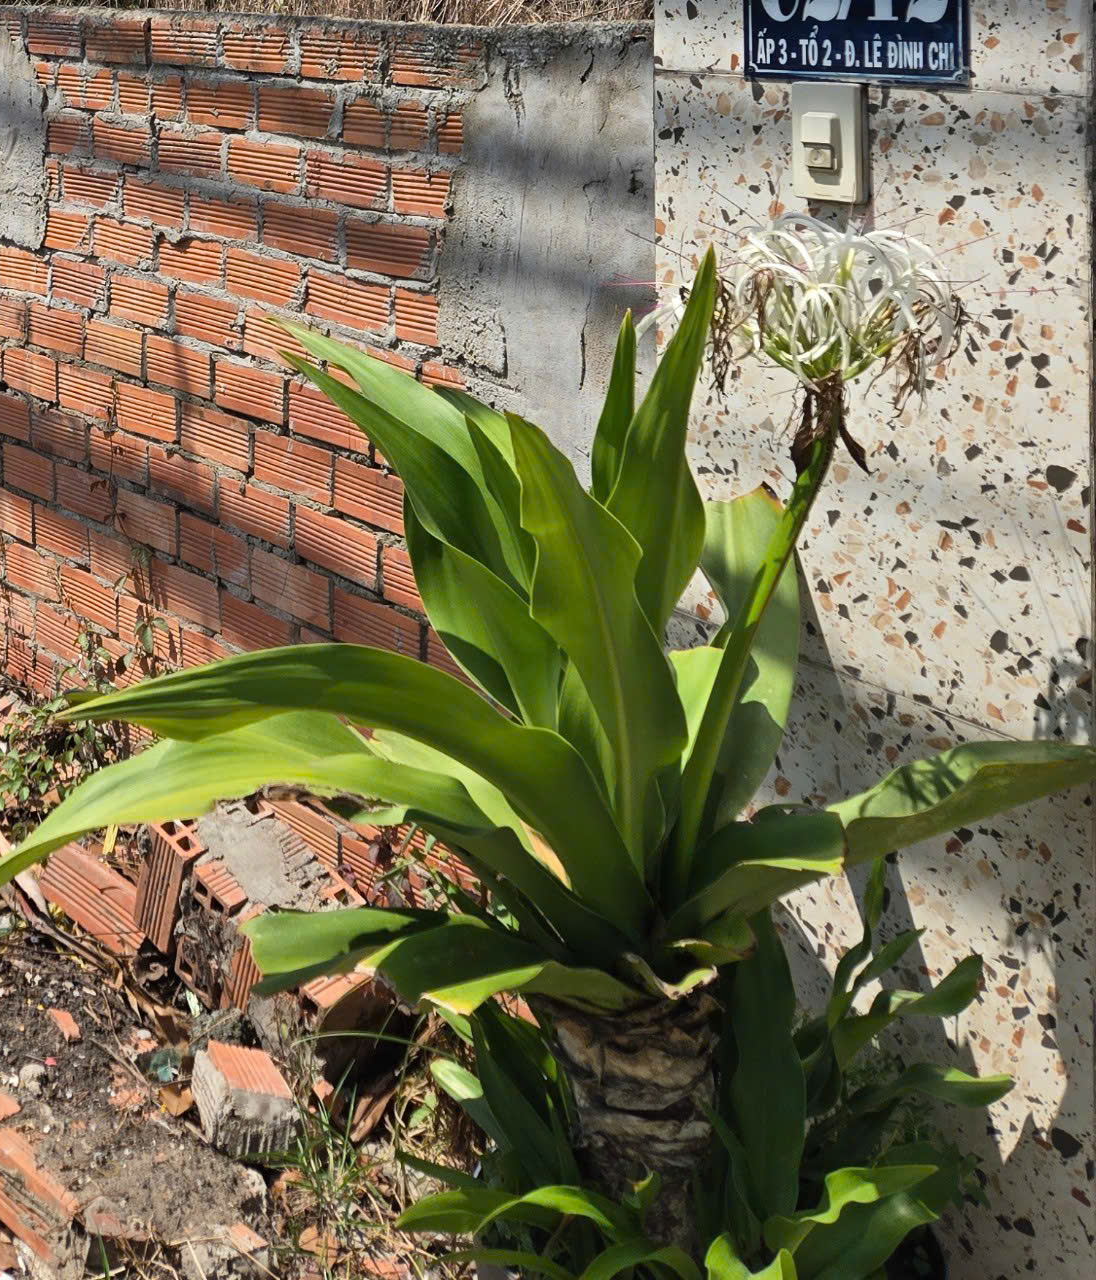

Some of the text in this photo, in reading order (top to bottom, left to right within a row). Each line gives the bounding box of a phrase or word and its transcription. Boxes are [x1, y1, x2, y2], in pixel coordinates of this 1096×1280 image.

[756, 27, 775, 64] ẤP
[778, 38, 788, 65] 3
[799, 25, 819, 66] TỔ
[822, 39, 832, 67] 2
[844, 39, 860, 68] Đ.
[864, 33, 883, 68] LÊ
[887, 33, 924, 70] ĐÌNH
[928, 40, 954, 71] CHI
